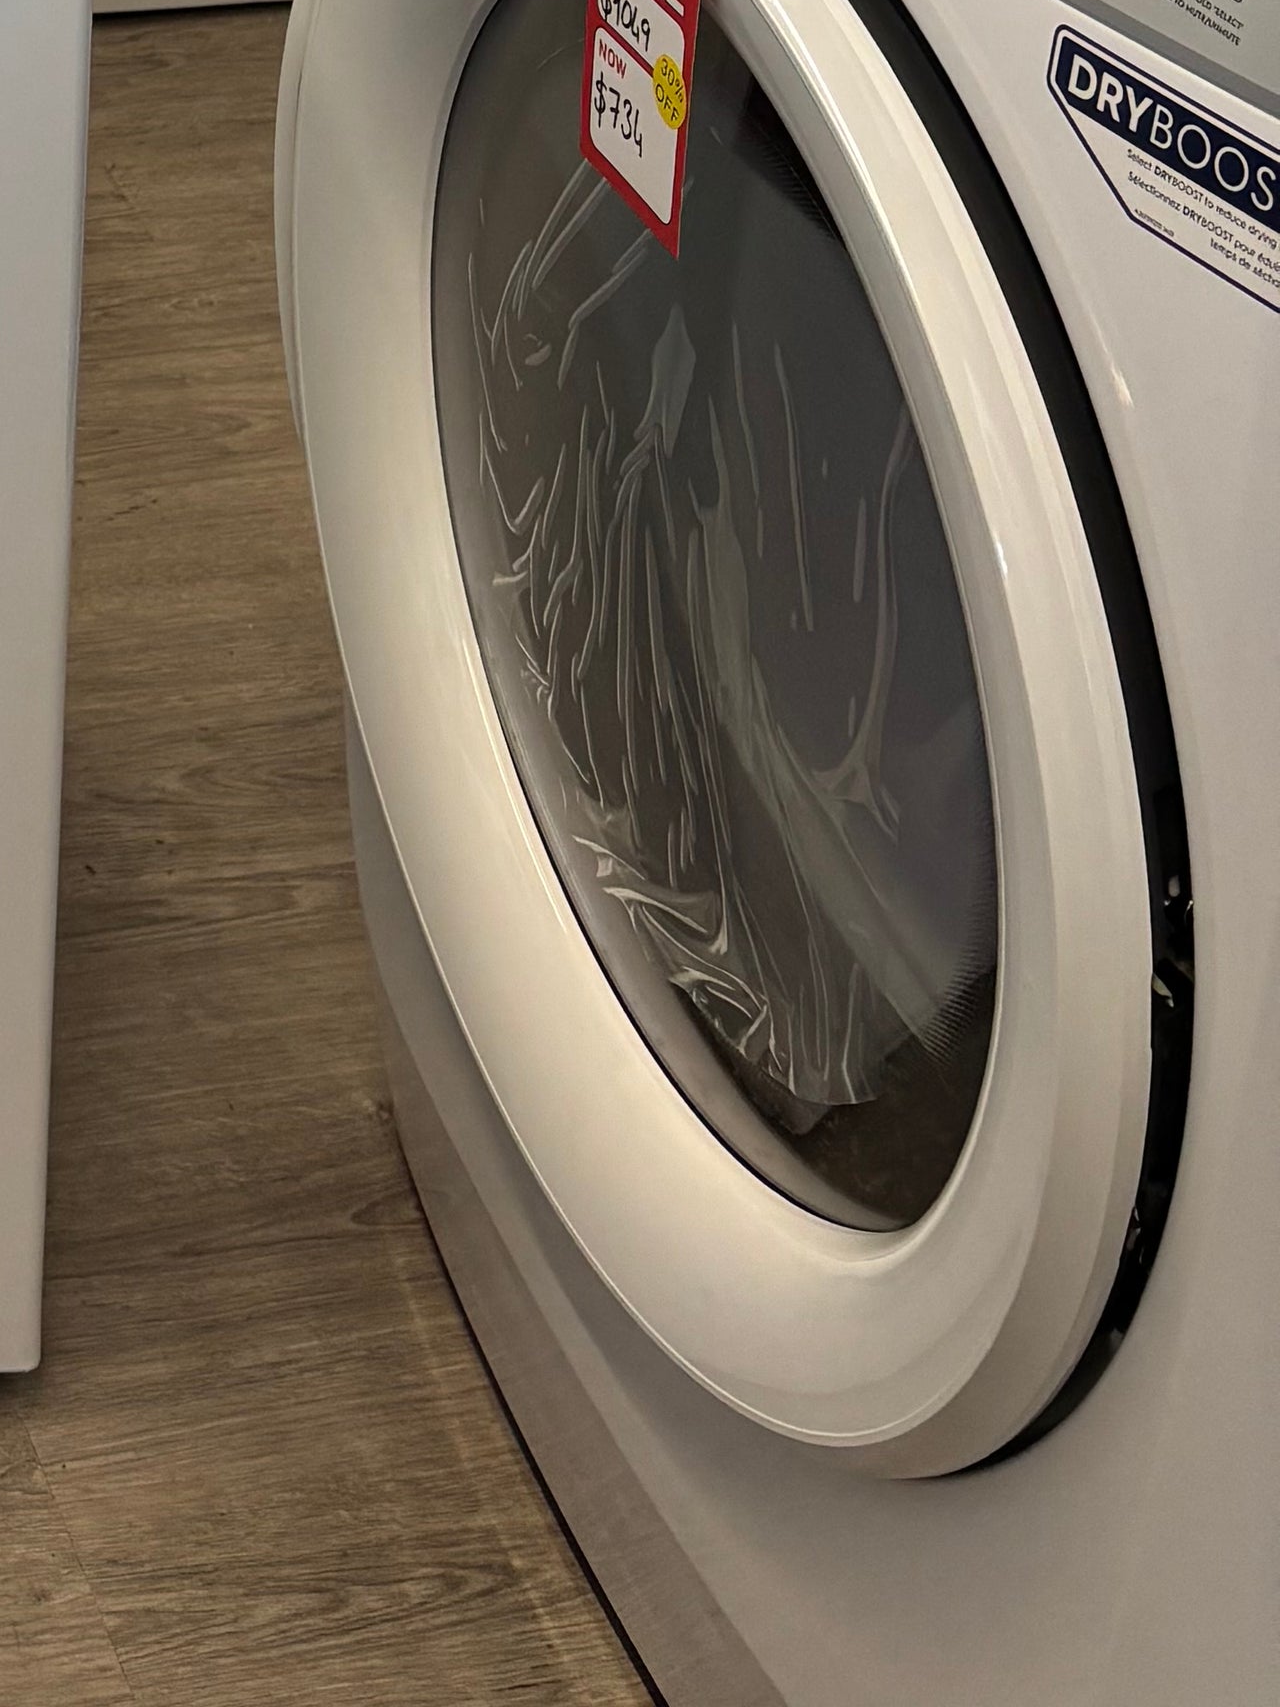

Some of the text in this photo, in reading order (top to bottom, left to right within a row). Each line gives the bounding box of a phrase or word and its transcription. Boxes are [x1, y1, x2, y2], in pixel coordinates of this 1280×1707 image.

[599, 39, 627, 79] NOW
[660, 58, 684, 103] 30%
[594, 71, 643, 158] $734
[655, 84, 679, 122] OFF
[1068, 54, 1277, 212] DRYBOOS
[1154, 166, 1204, 203] DRYBOOST
[1182, 205, 1234, 242] DRYBOOST
